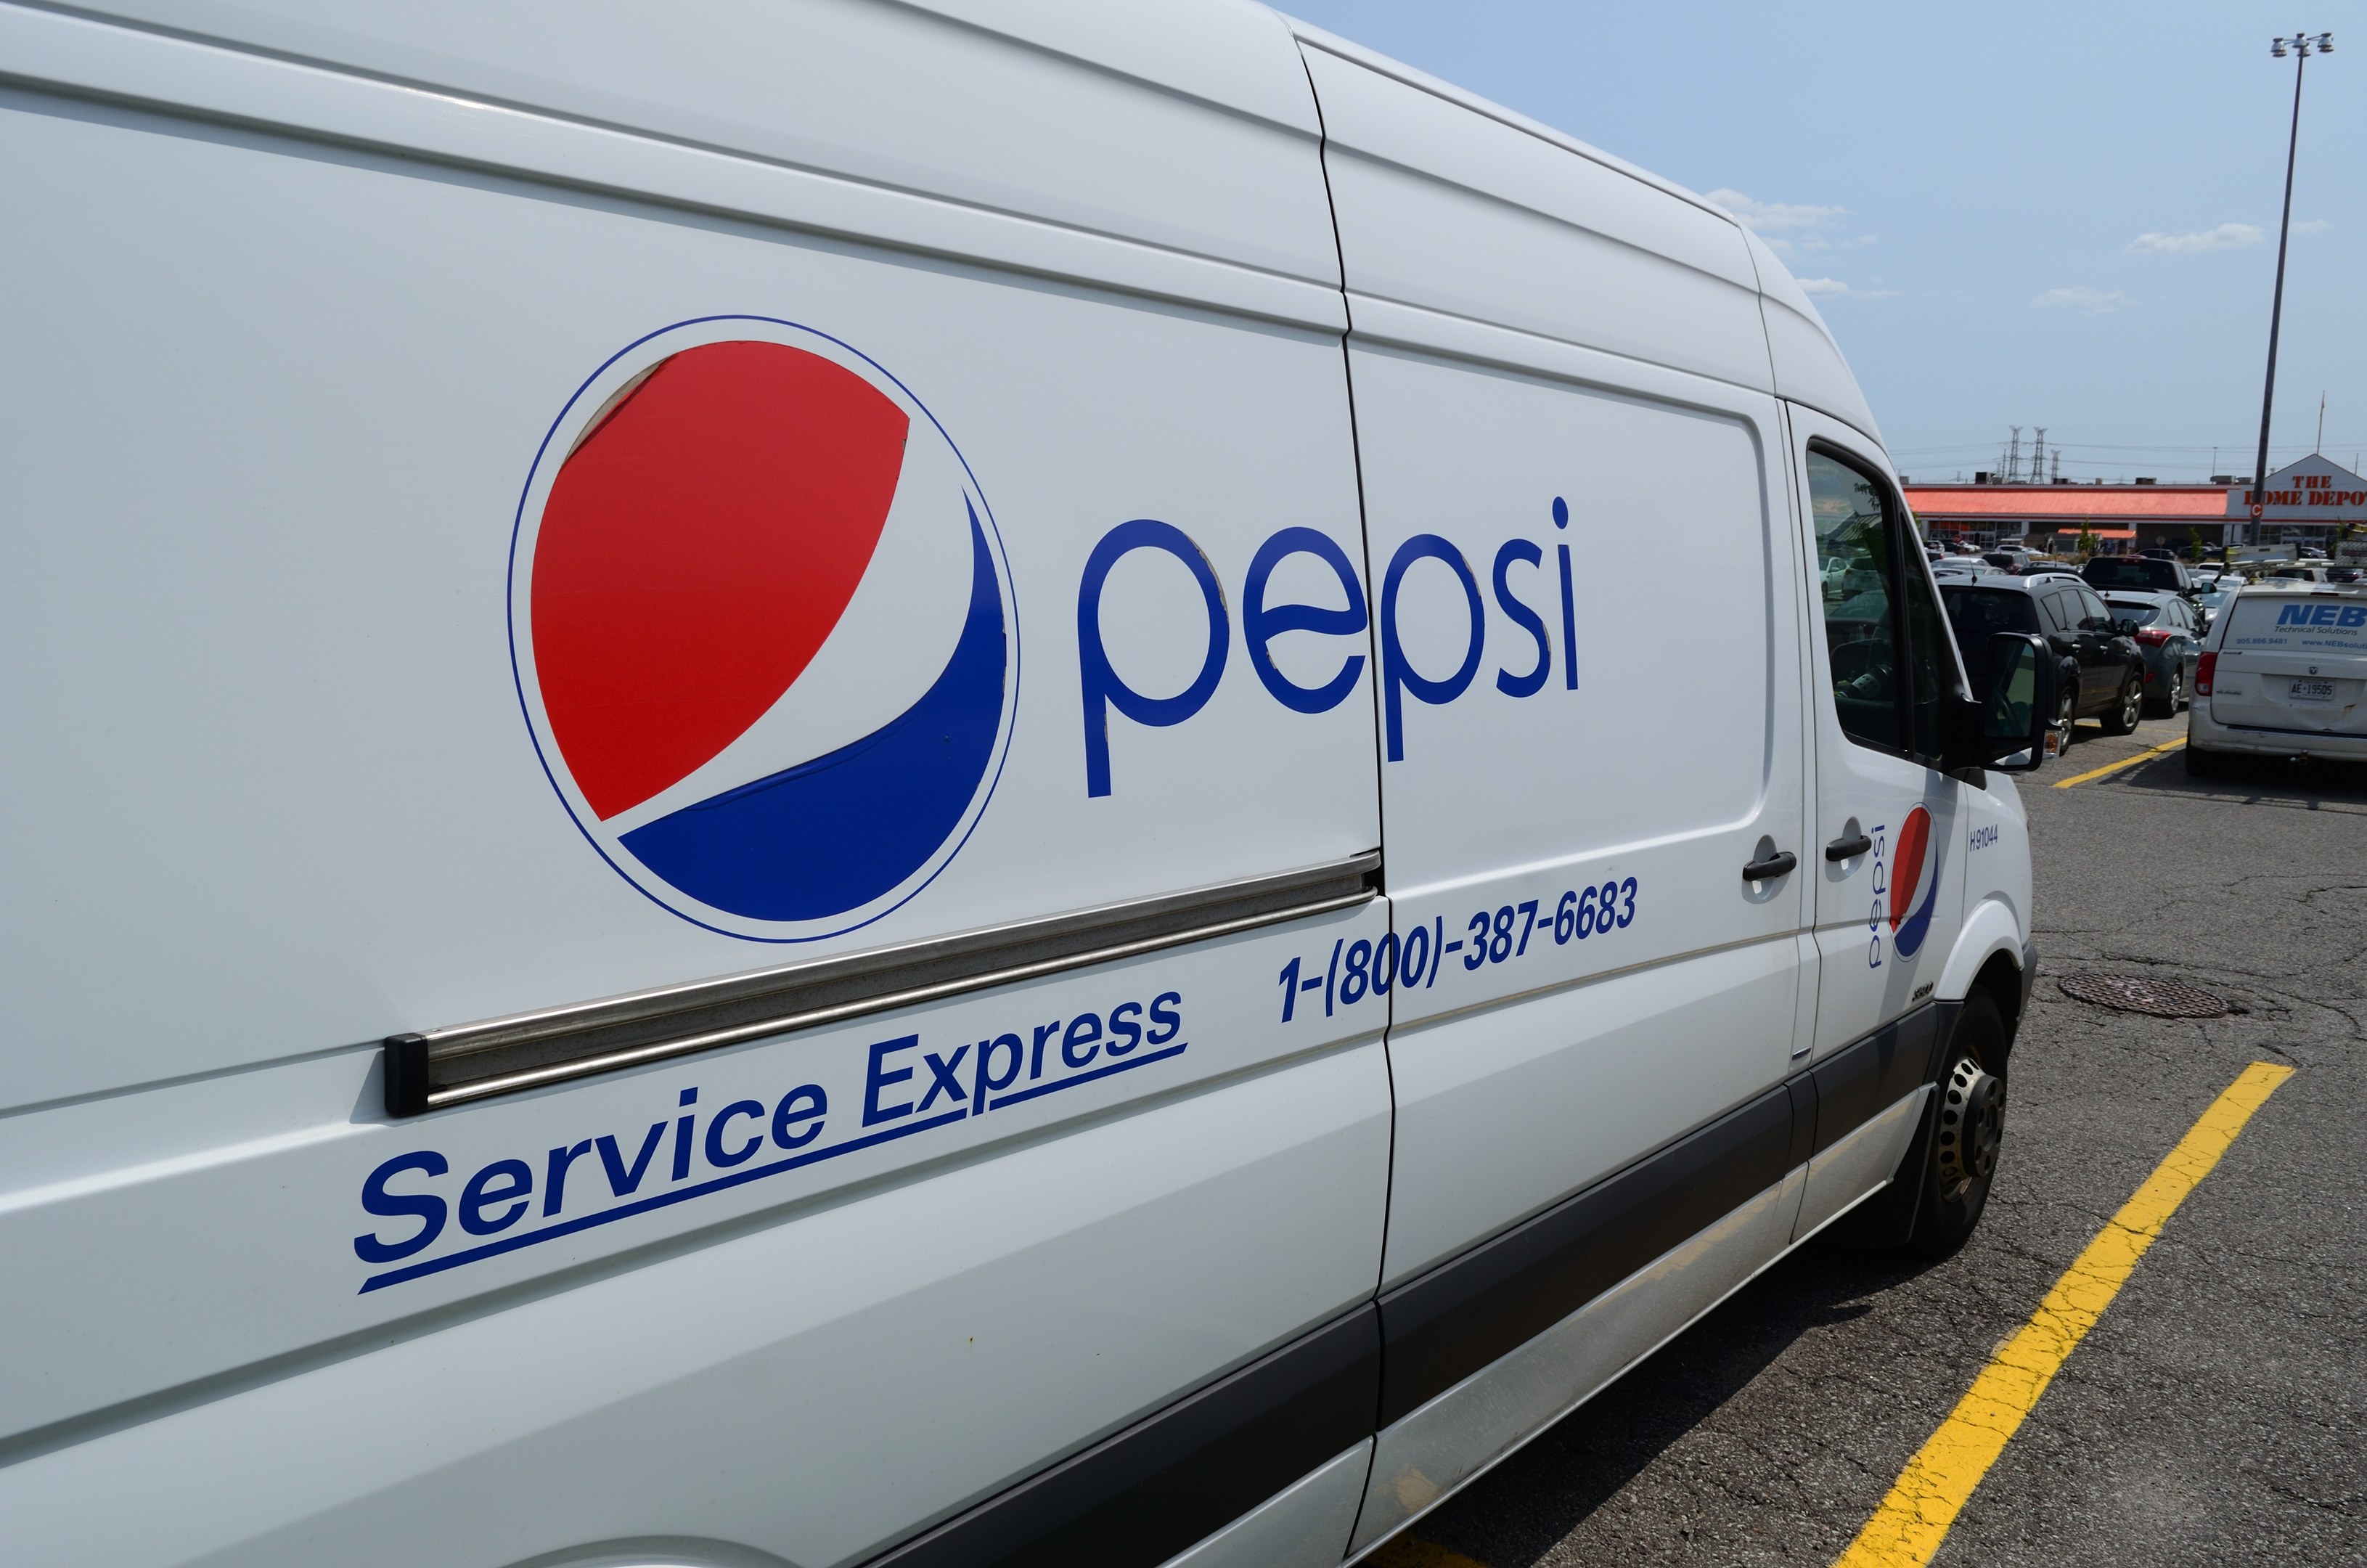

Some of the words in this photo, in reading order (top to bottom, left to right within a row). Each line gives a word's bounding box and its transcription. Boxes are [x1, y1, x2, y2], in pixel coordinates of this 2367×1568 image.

[2292, 475, 2332, 489] THE
[2252, 504, 2262, 516] C
[2308, 491, 2367, 506] DEPO
[2276, 604, 2367, 627] NEB
[2274, 625, 2315, 634] Technical
[2316, 626, 2358, 636] Solutions
[1077, 497, 1579, 799] pepsi
[1969, 824, 1998, 852] H91044
[1869, 825, 1886, 969] pepsi
[1277, 876, 1638, 1024] 1-(800)-387-6683
[353, 1087, 827, 1264] Service
[861, 991, 1182, 1118] Express
